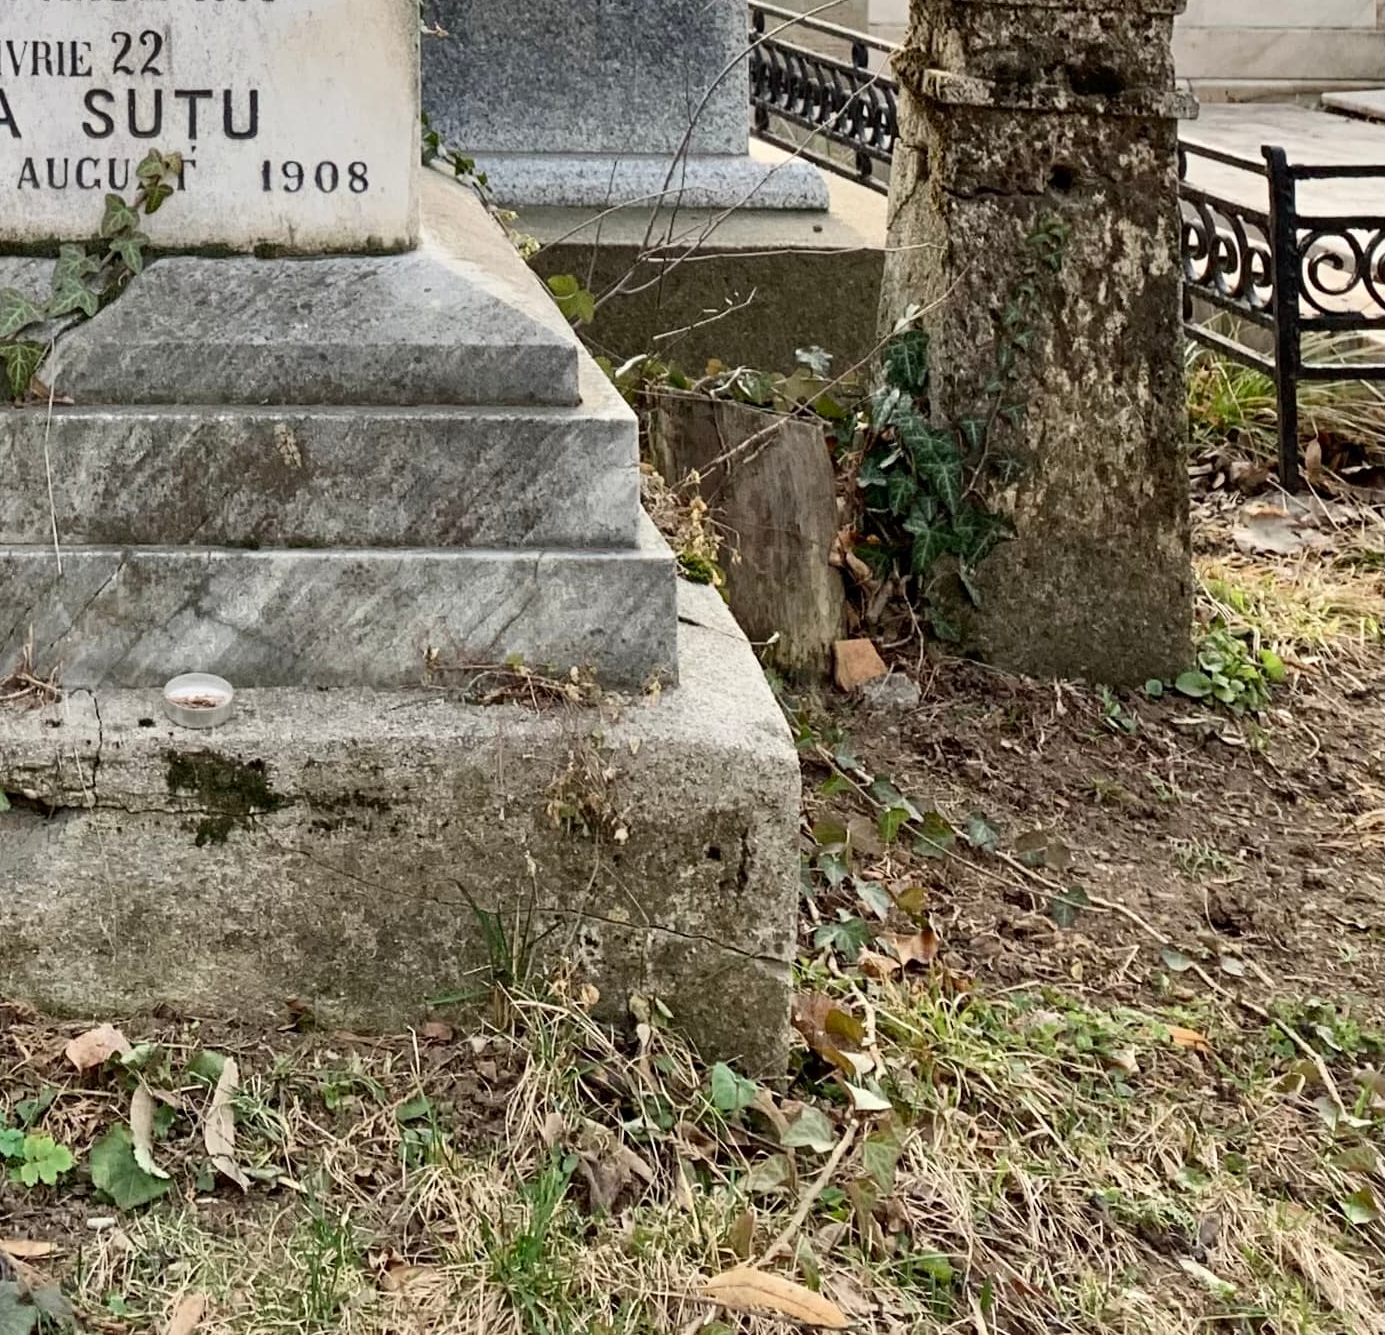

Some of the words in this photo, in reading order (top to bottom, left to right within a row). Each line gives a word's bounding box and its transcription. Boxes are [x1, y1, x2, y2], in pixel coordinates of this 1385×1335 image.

[110, 29, 164, 76] 22
[17, 156, 197, 192] AUGUT
[260, 159, 370, 193] 1908
